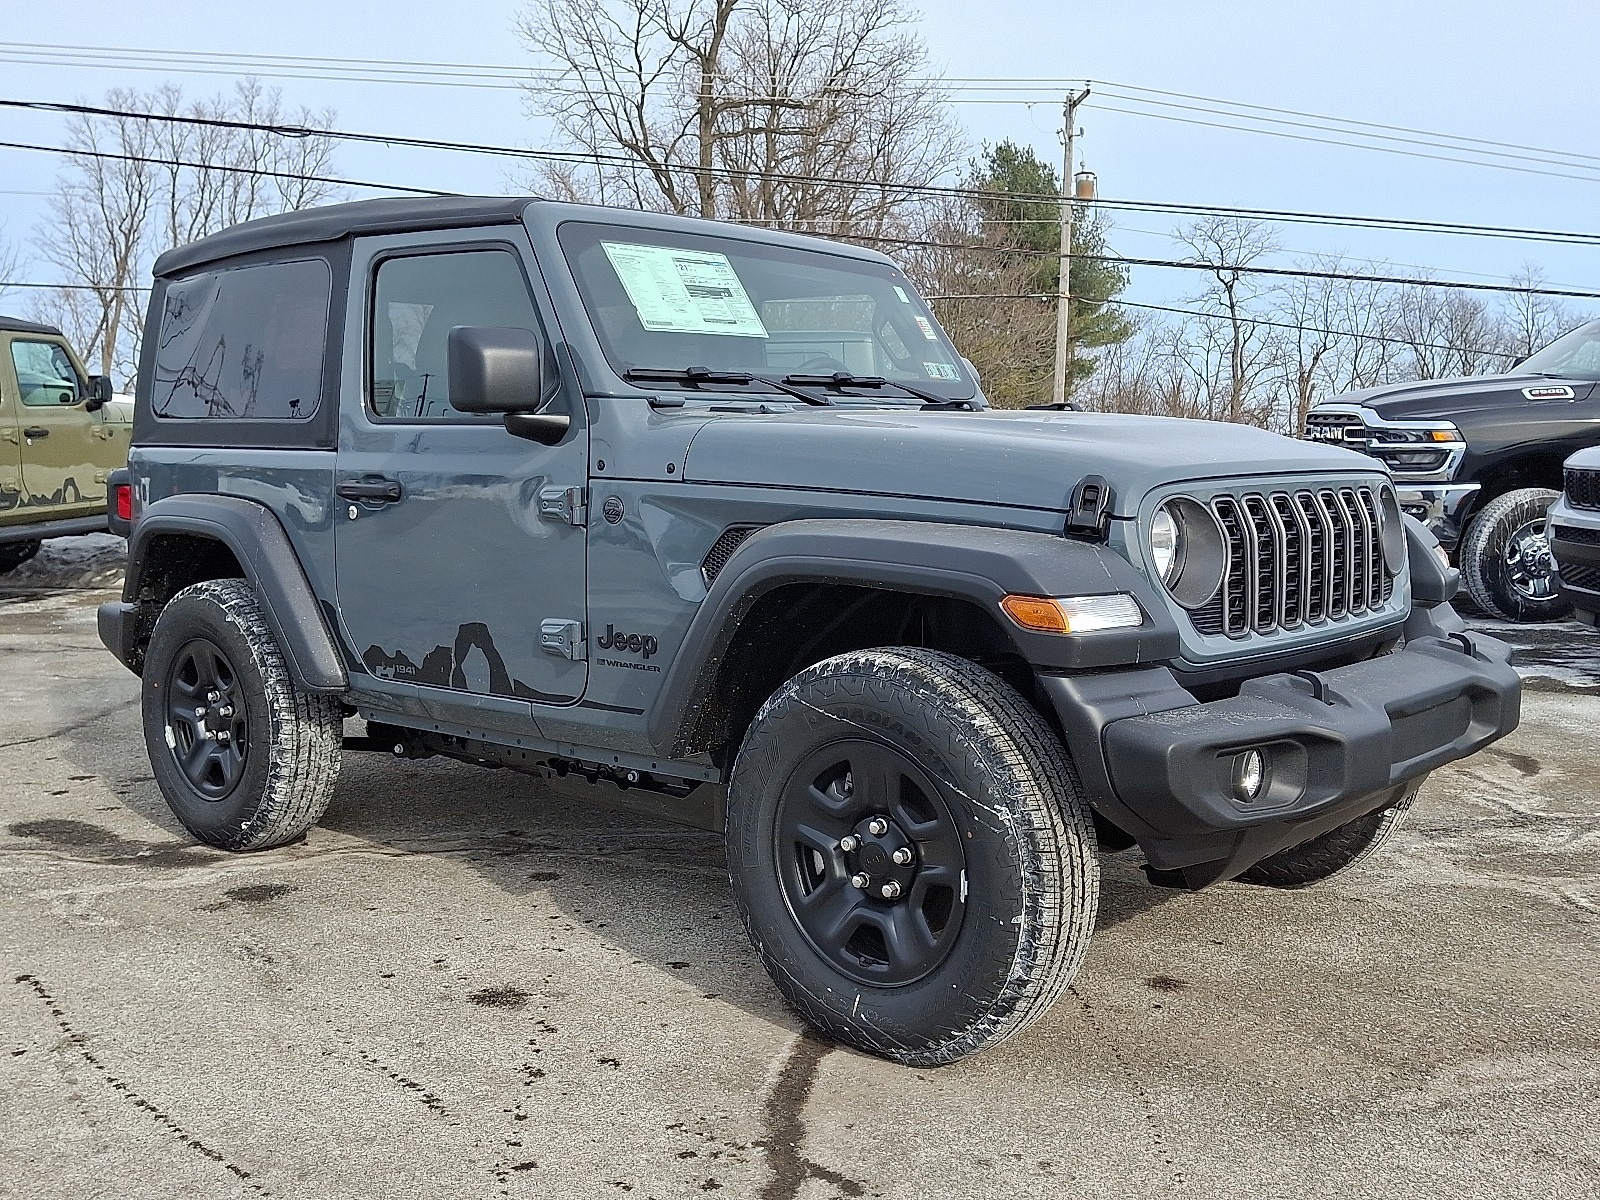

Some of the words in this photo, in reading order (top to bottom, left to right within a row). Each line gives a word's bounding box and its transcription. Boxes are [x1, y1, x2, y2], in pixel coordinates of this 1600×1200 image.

[1311, 426, 1343, 440] RAM
[597, 624, 658, 660] Jeep
[395, 664, 416, 676] 1941
[605, 659, 661, 673] WRANGLER
